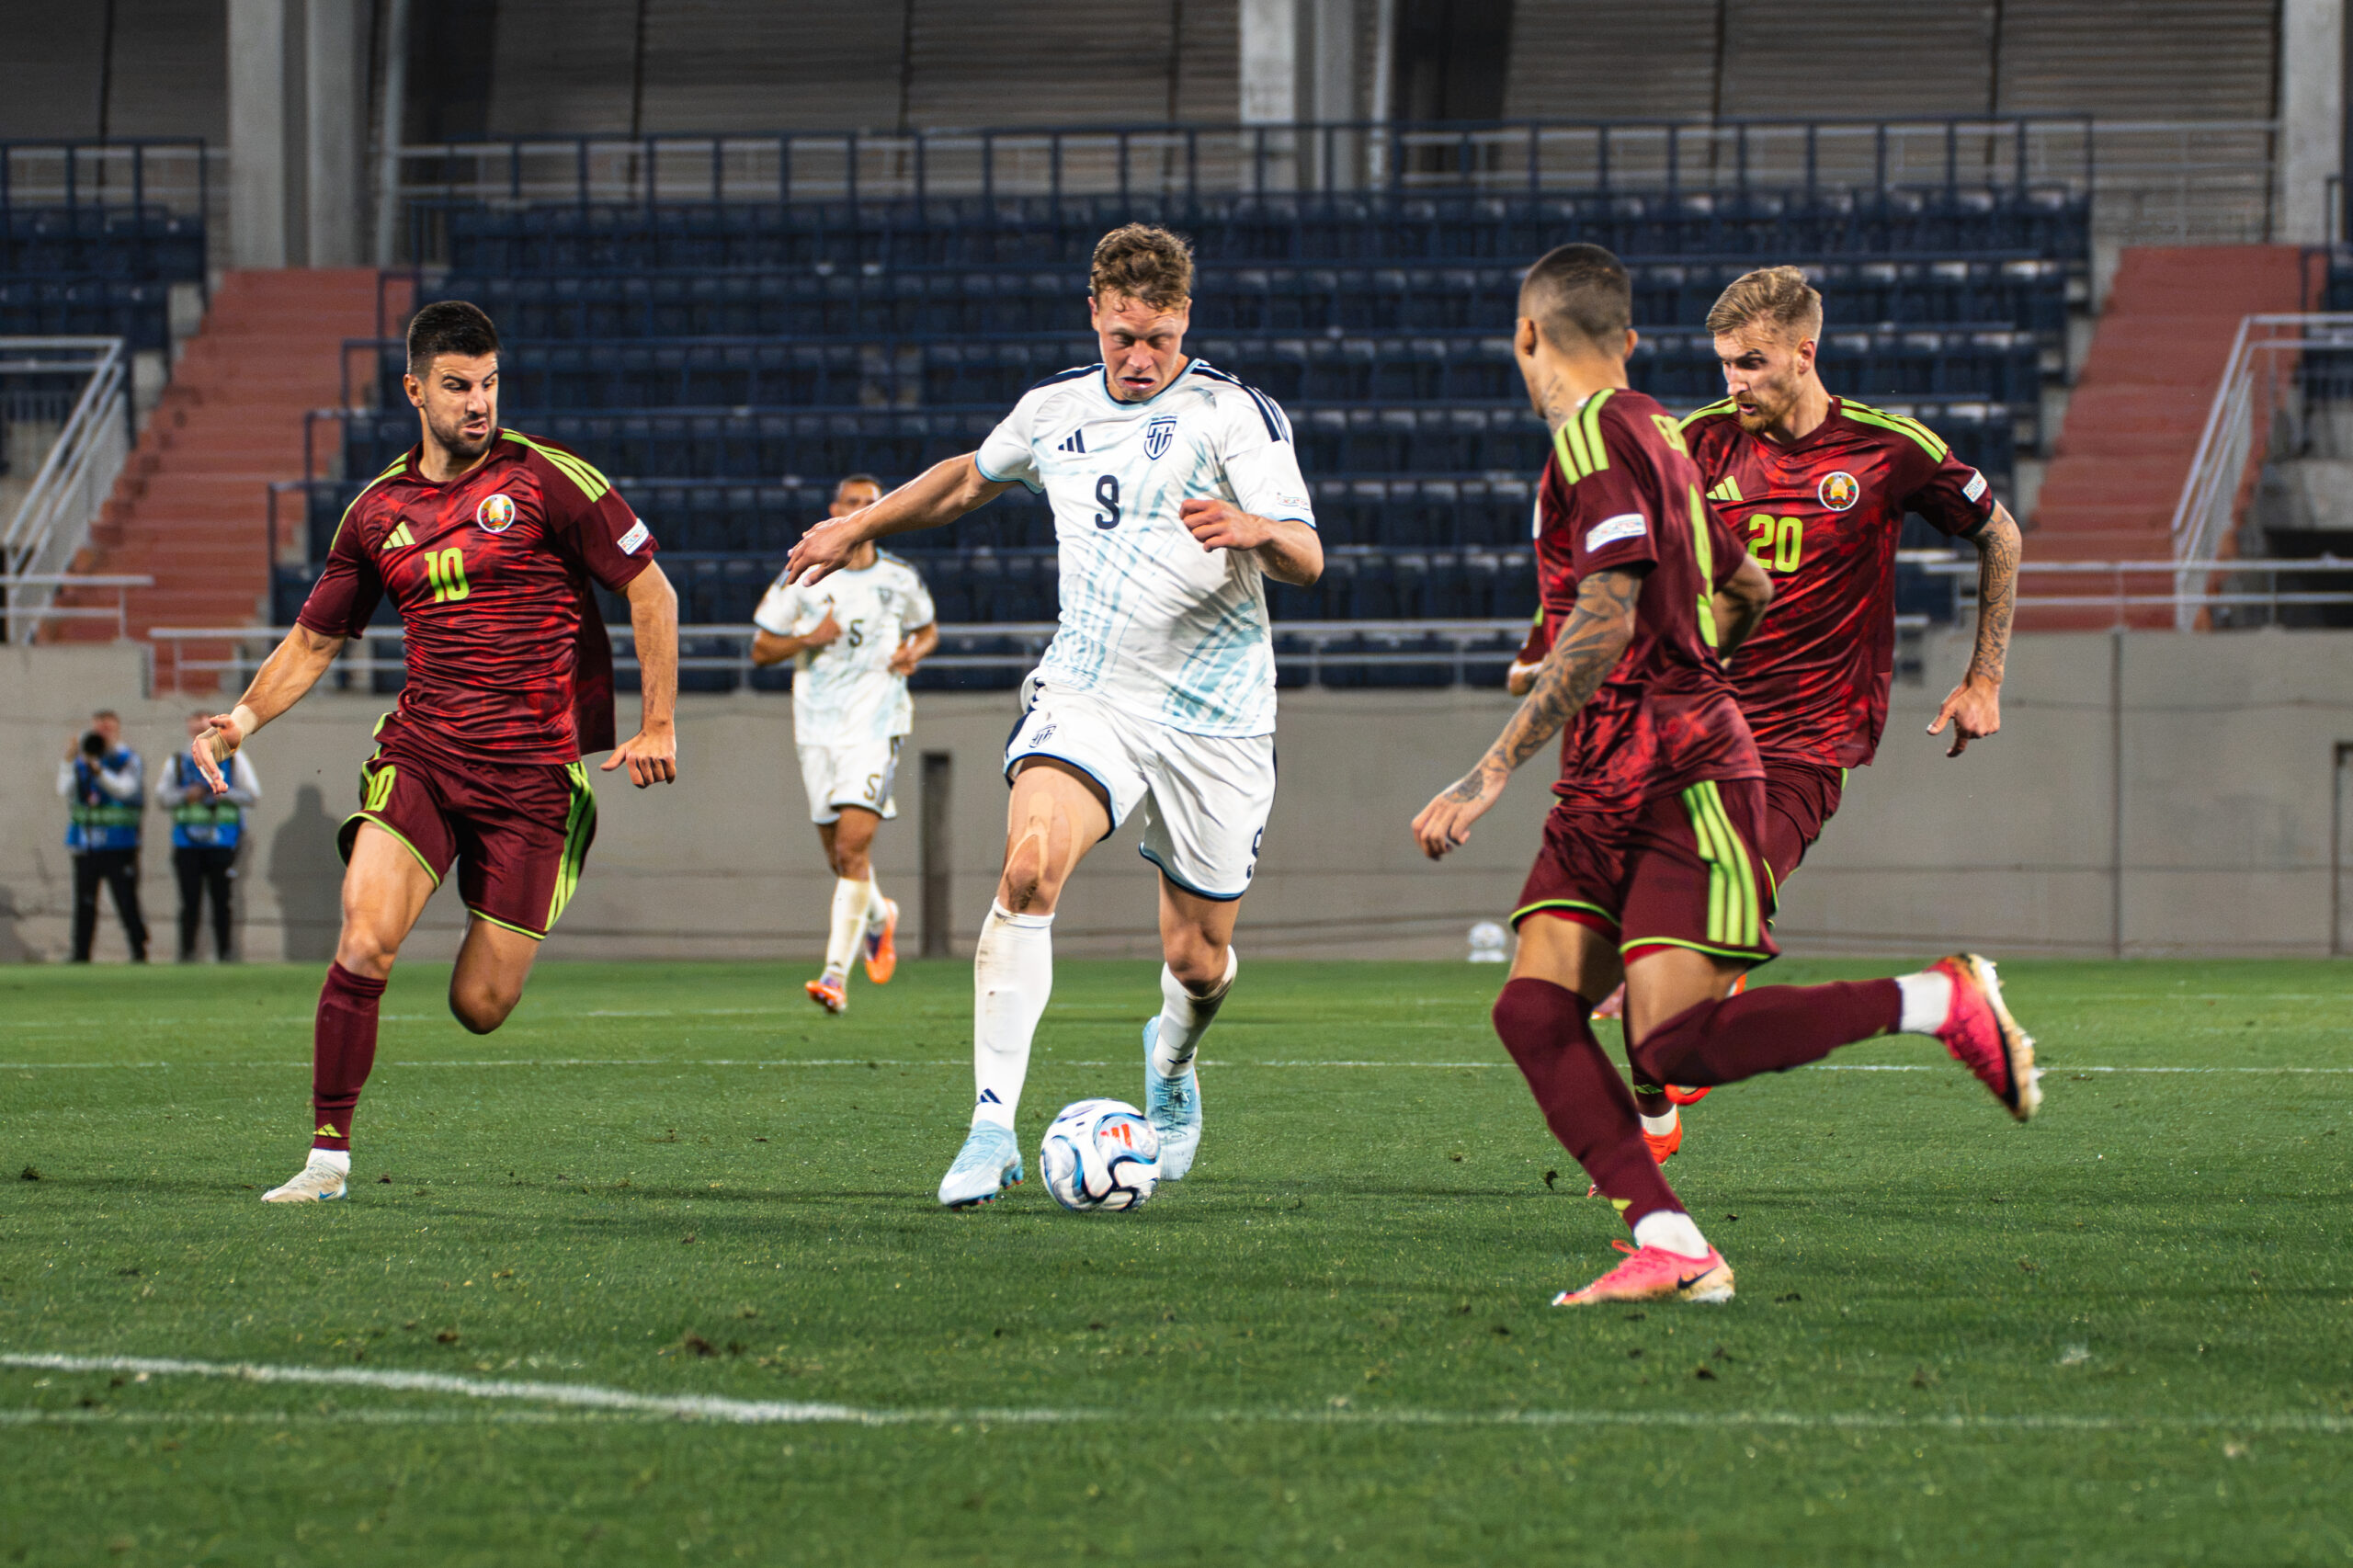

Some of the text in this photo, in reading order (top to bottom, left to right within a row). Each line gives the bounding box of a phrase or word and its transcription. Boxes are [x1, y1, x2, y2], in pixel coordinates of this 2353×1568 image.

[1096, 474, 1120, 529] 9
[1748, 514, 1802, 573] 20
[424, 547, 470, 602] 10
[848, 619, 864, 648] 5
[365, 765, 396, 812] 10
[864, 773, 881, 801] 5
